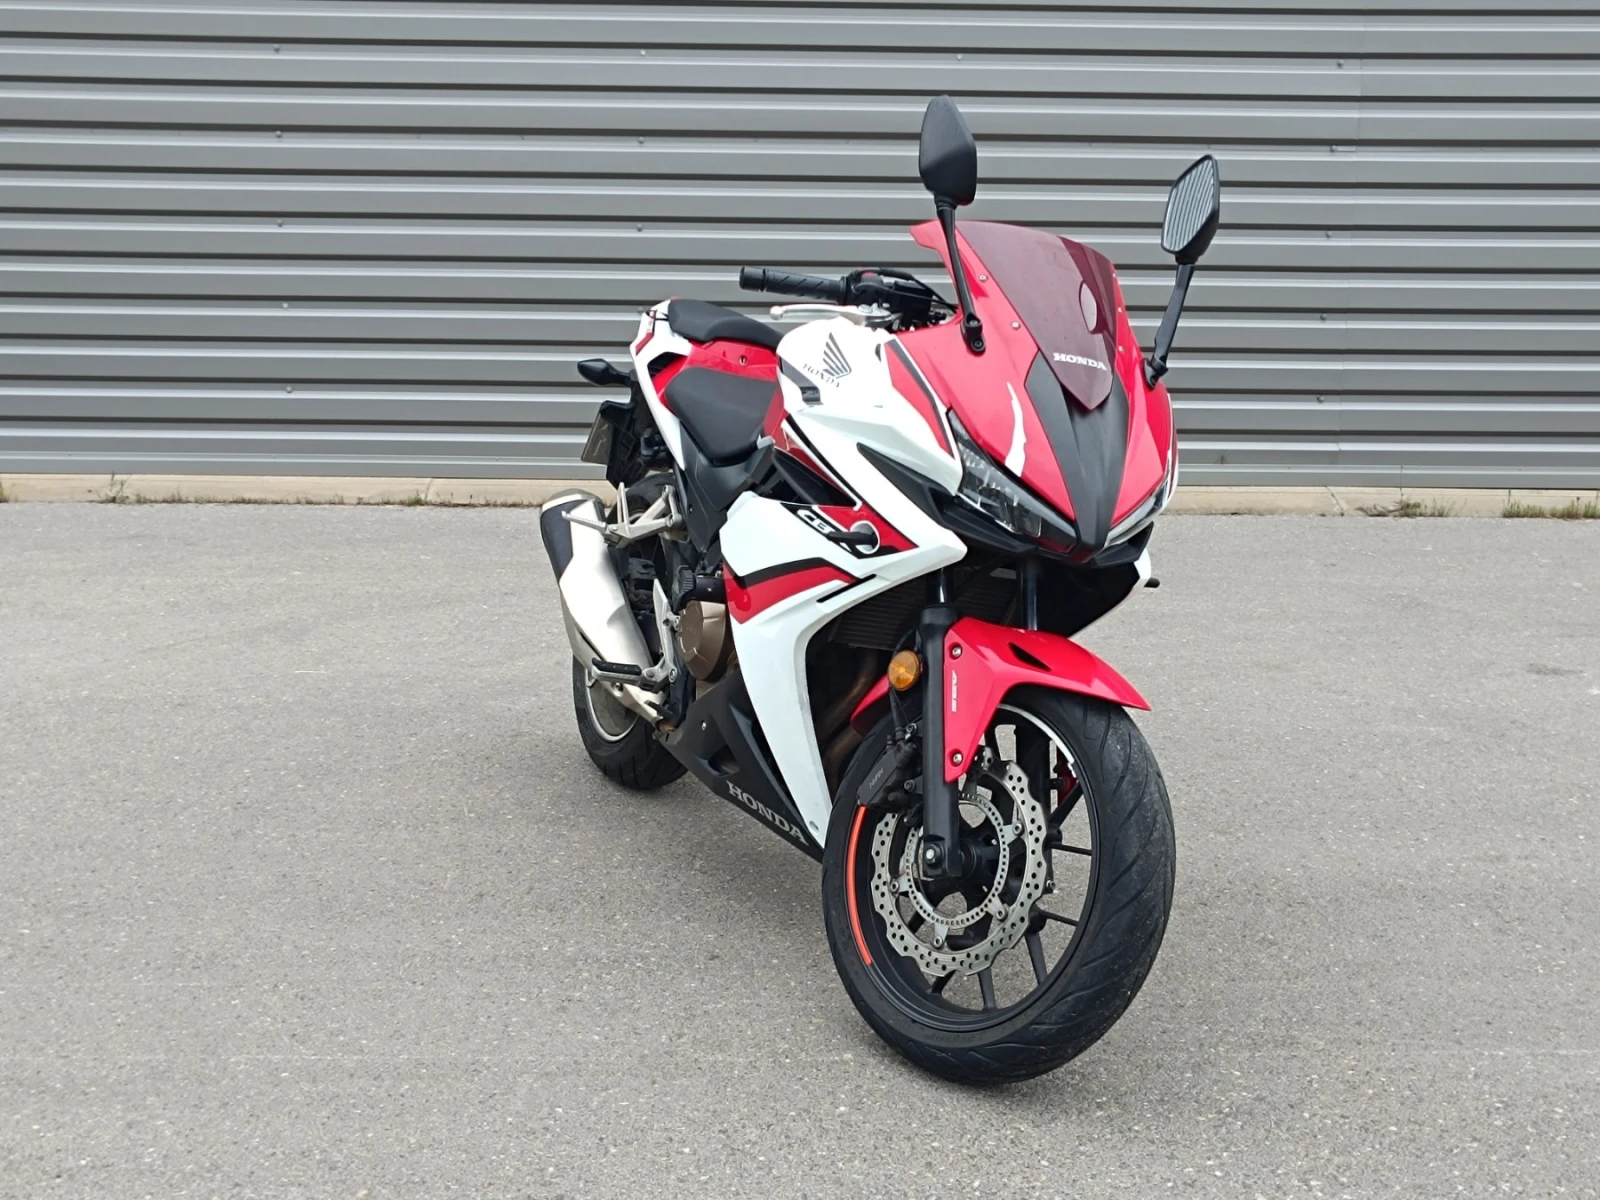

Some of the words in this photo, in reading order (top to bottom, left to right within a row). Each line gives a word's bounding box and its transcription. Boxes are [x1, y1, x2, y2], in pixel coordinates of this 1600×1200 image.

[1052, 352, 1108, 371] HONDA
[802, 363, 840, 388] HONDA
[726, 780, 809, 846] HONDA
